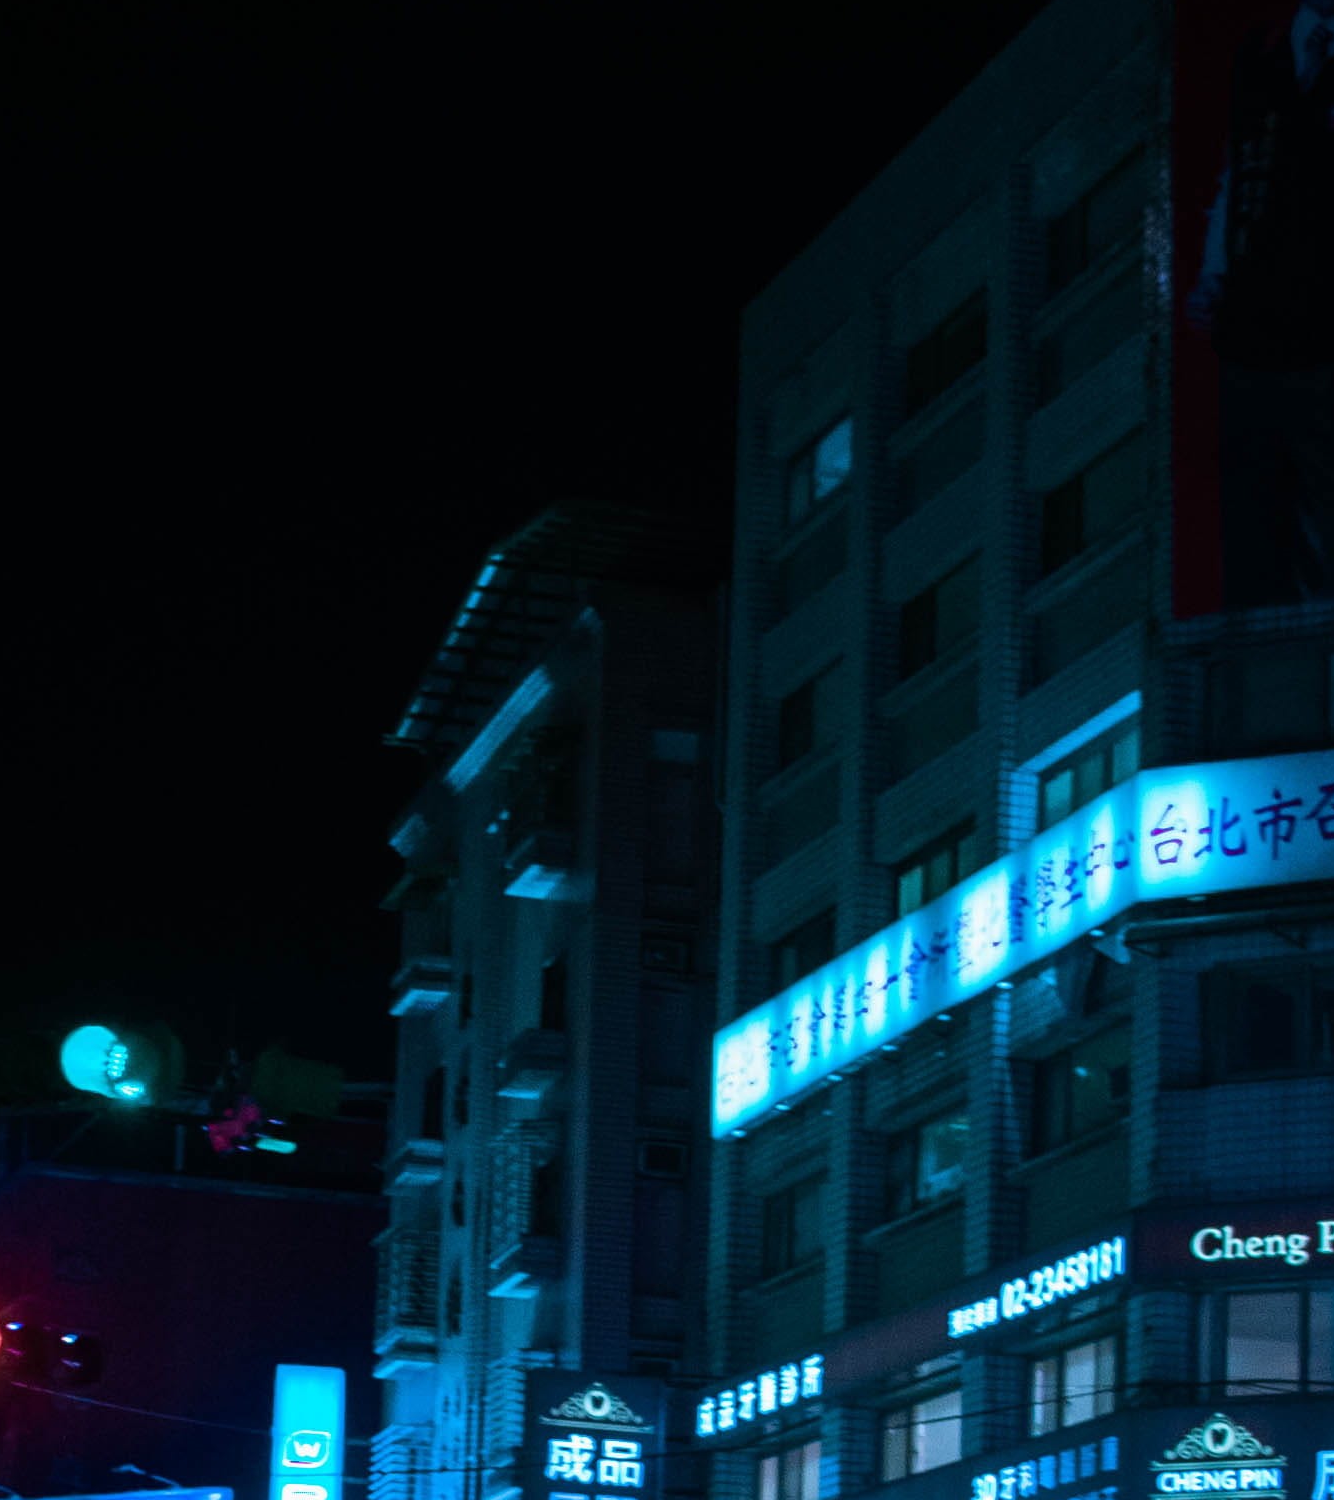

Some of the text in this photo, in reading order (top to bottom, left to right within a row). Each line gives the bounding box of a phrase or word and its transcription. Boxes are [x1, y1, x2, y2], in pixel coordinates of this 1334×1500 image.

[1191, 1223, 1309, 1264] Cheng
[544, 1433, 645, 1489] 成品
[1157, 1466, 1283, 1494] CHENG PIN
